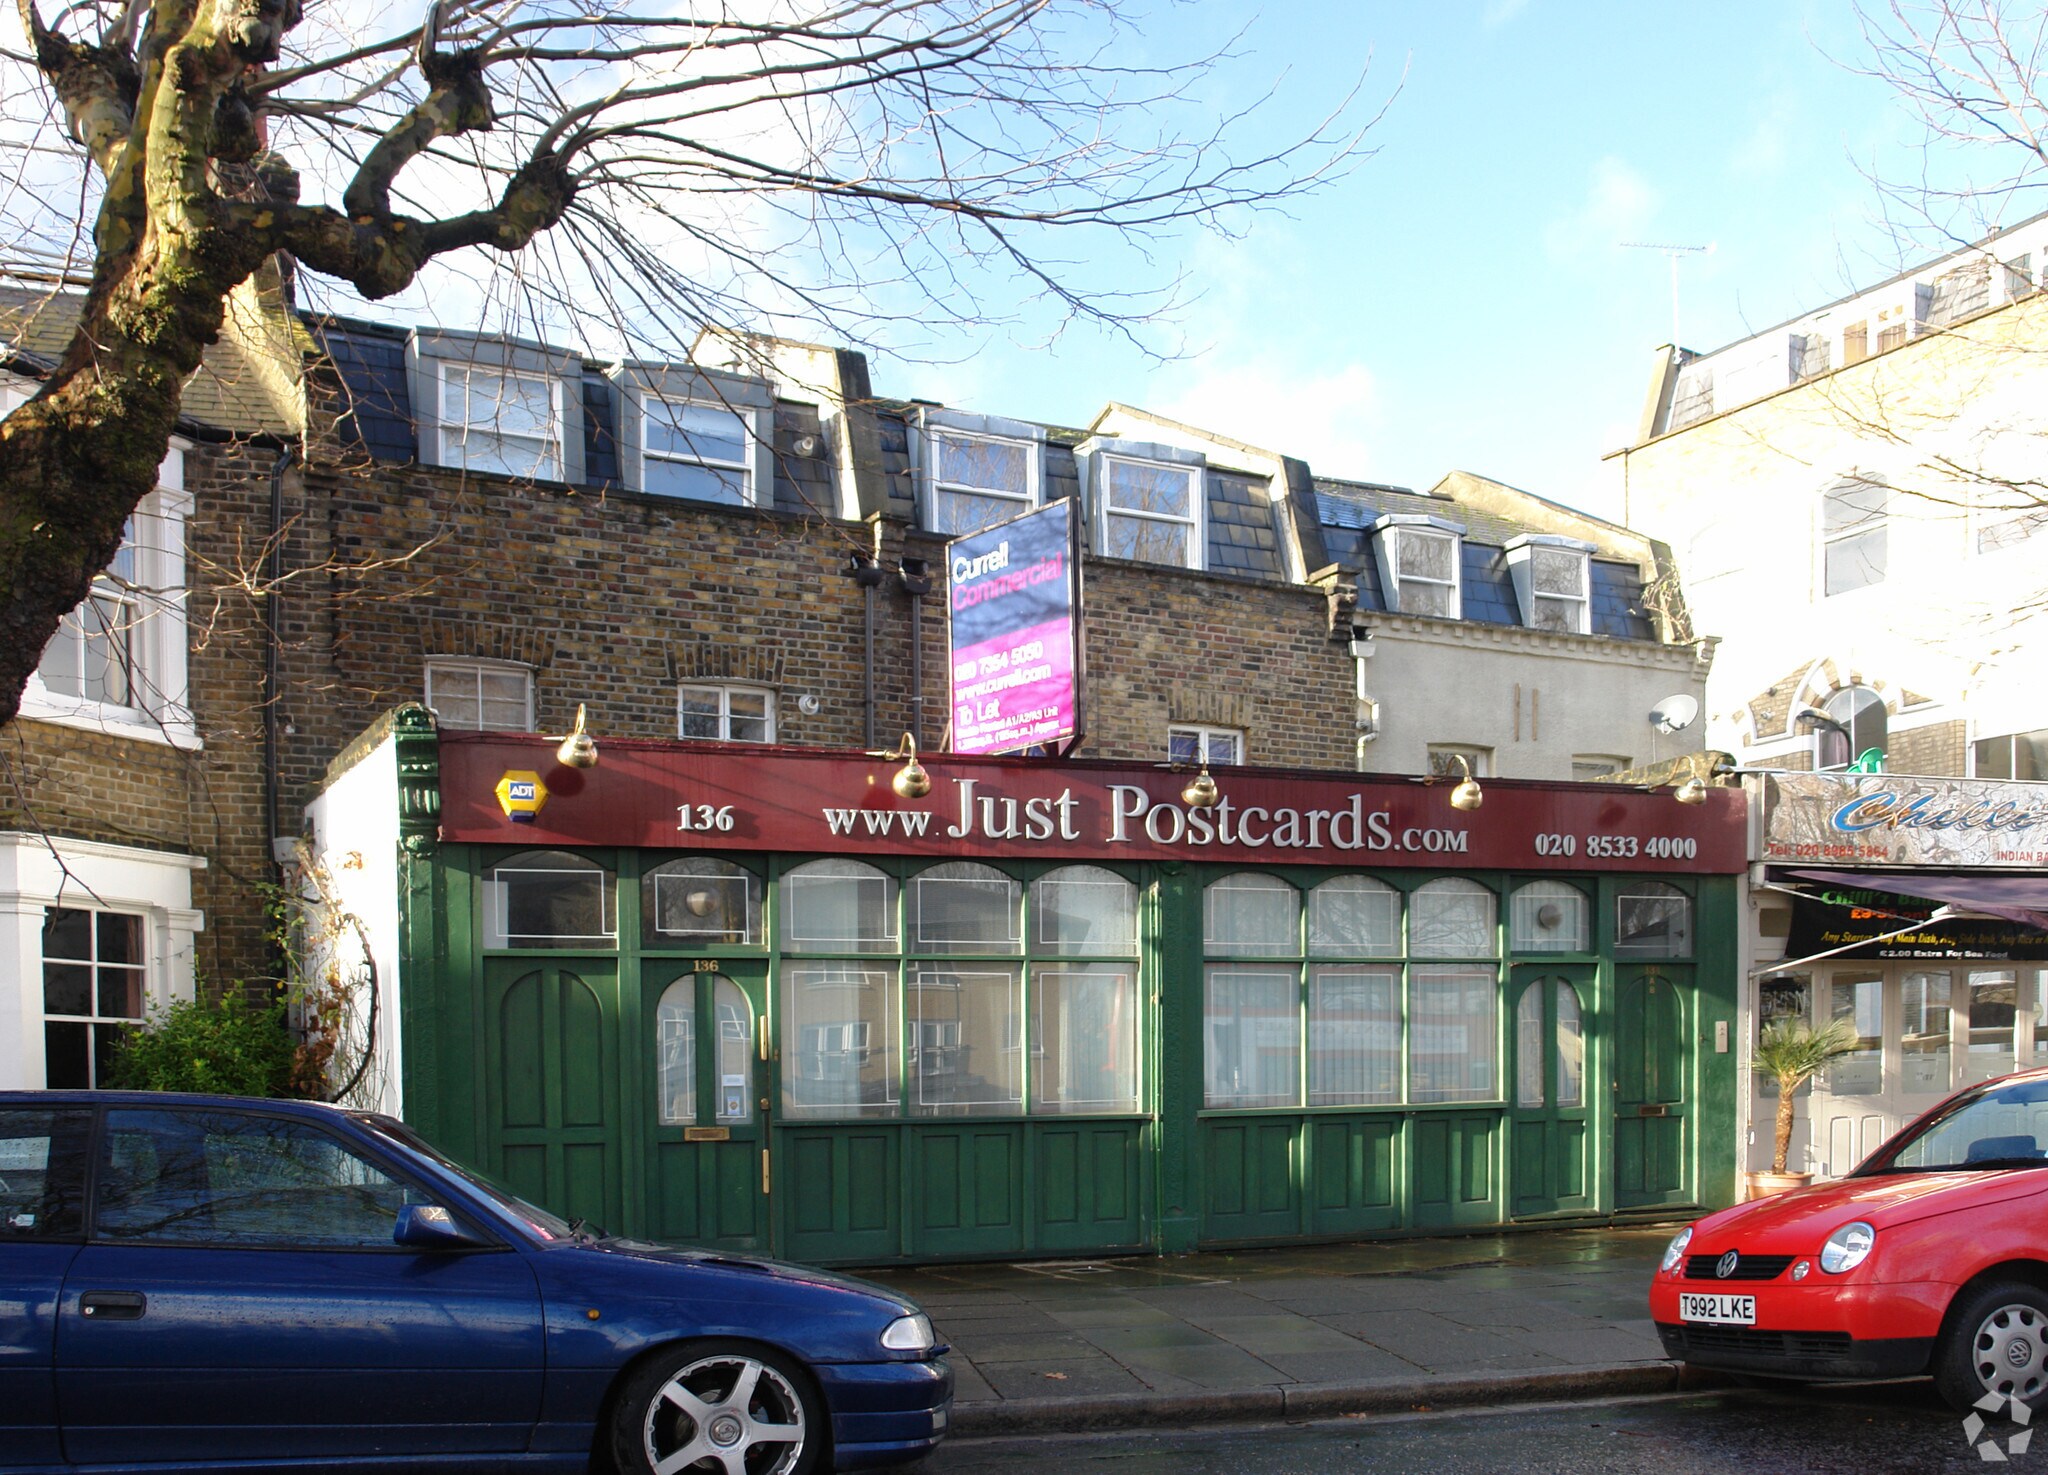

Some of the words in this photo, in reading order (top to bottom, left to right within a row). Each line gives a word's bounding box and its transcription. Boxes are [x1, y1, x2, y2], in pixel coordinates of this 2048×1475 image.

[952, 541, 1009, 584] Currell
[953, 551, 1063, 611] Commercial
[957, 705, 974, 726] To
[977, 699, 1000, 721] Let
[511, 786, 534, 797] ADT
[677, 804, 734, 831] 136
[1535, 833, 1576, 857] 020
[1587, 835, 1639, 858] 8533
[1645, 837, 1697, 859] 4000
[1768, 844, 1791, 855] Tel:
[1795, 844, 1819, 856] 020
[1823, 845, 1854, 857] 8985
[1997, 851, 2033, 861] INDIAN
[1821, 931, 1840, 945] Any
[1895, 933, 1917, 943] Main
[1999, 934, 2016, 946] Any
[1965, 950, 1984, 958] Sea
[693, 960, 719, 972] 136
[1682, 1296, 1717, 1317] T992
[1720, 1297, 1754, 1319] LKE
